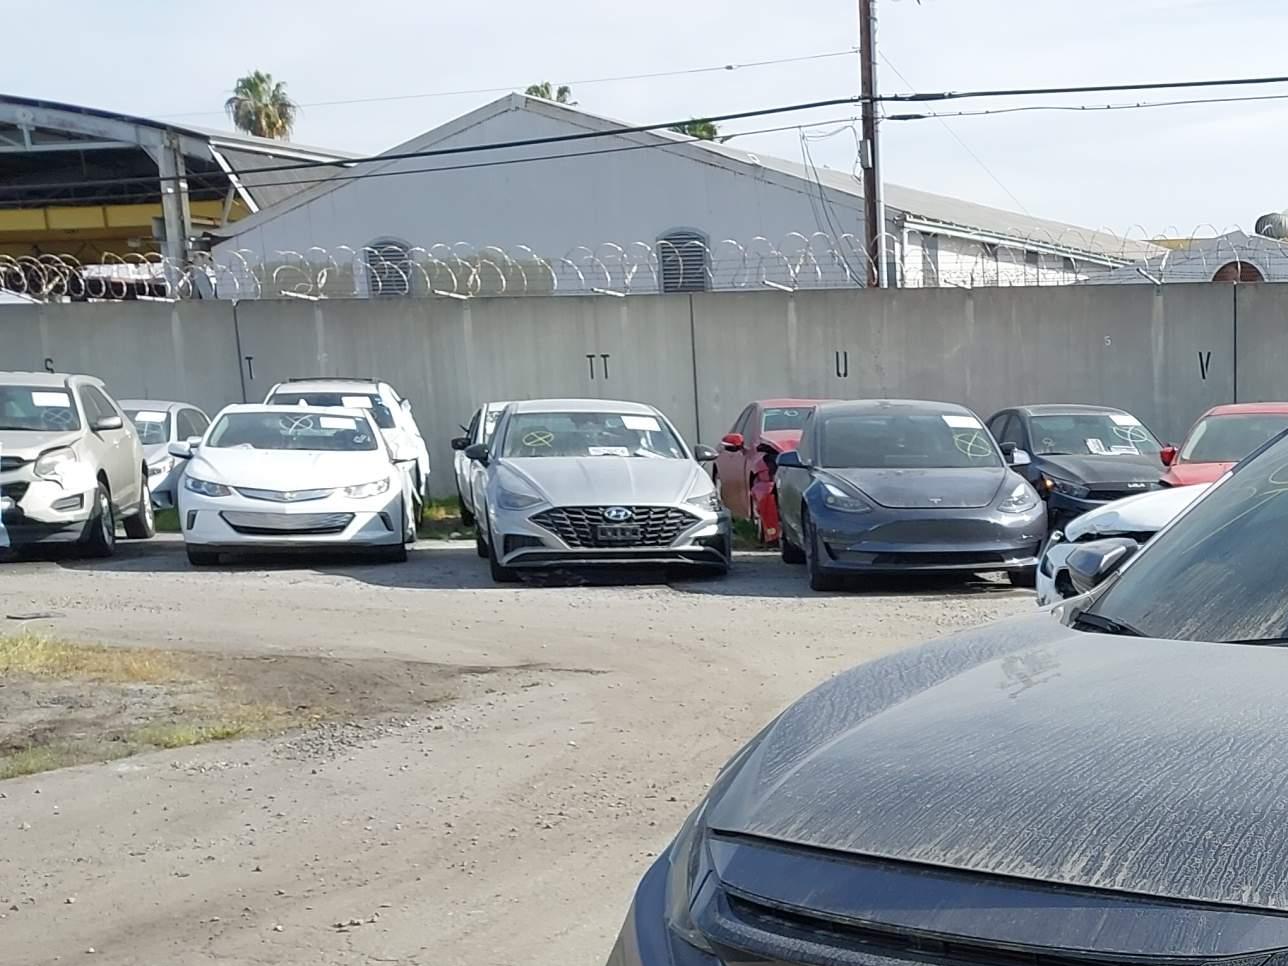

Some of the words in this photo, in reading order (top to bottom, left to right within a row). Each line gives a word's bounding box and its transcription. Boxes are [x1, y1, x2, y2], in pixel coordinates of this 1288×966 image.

[246, 356, 255, 379] T
[835, 351, 848, 378] U
[1198, 351, 1212, 380] V
